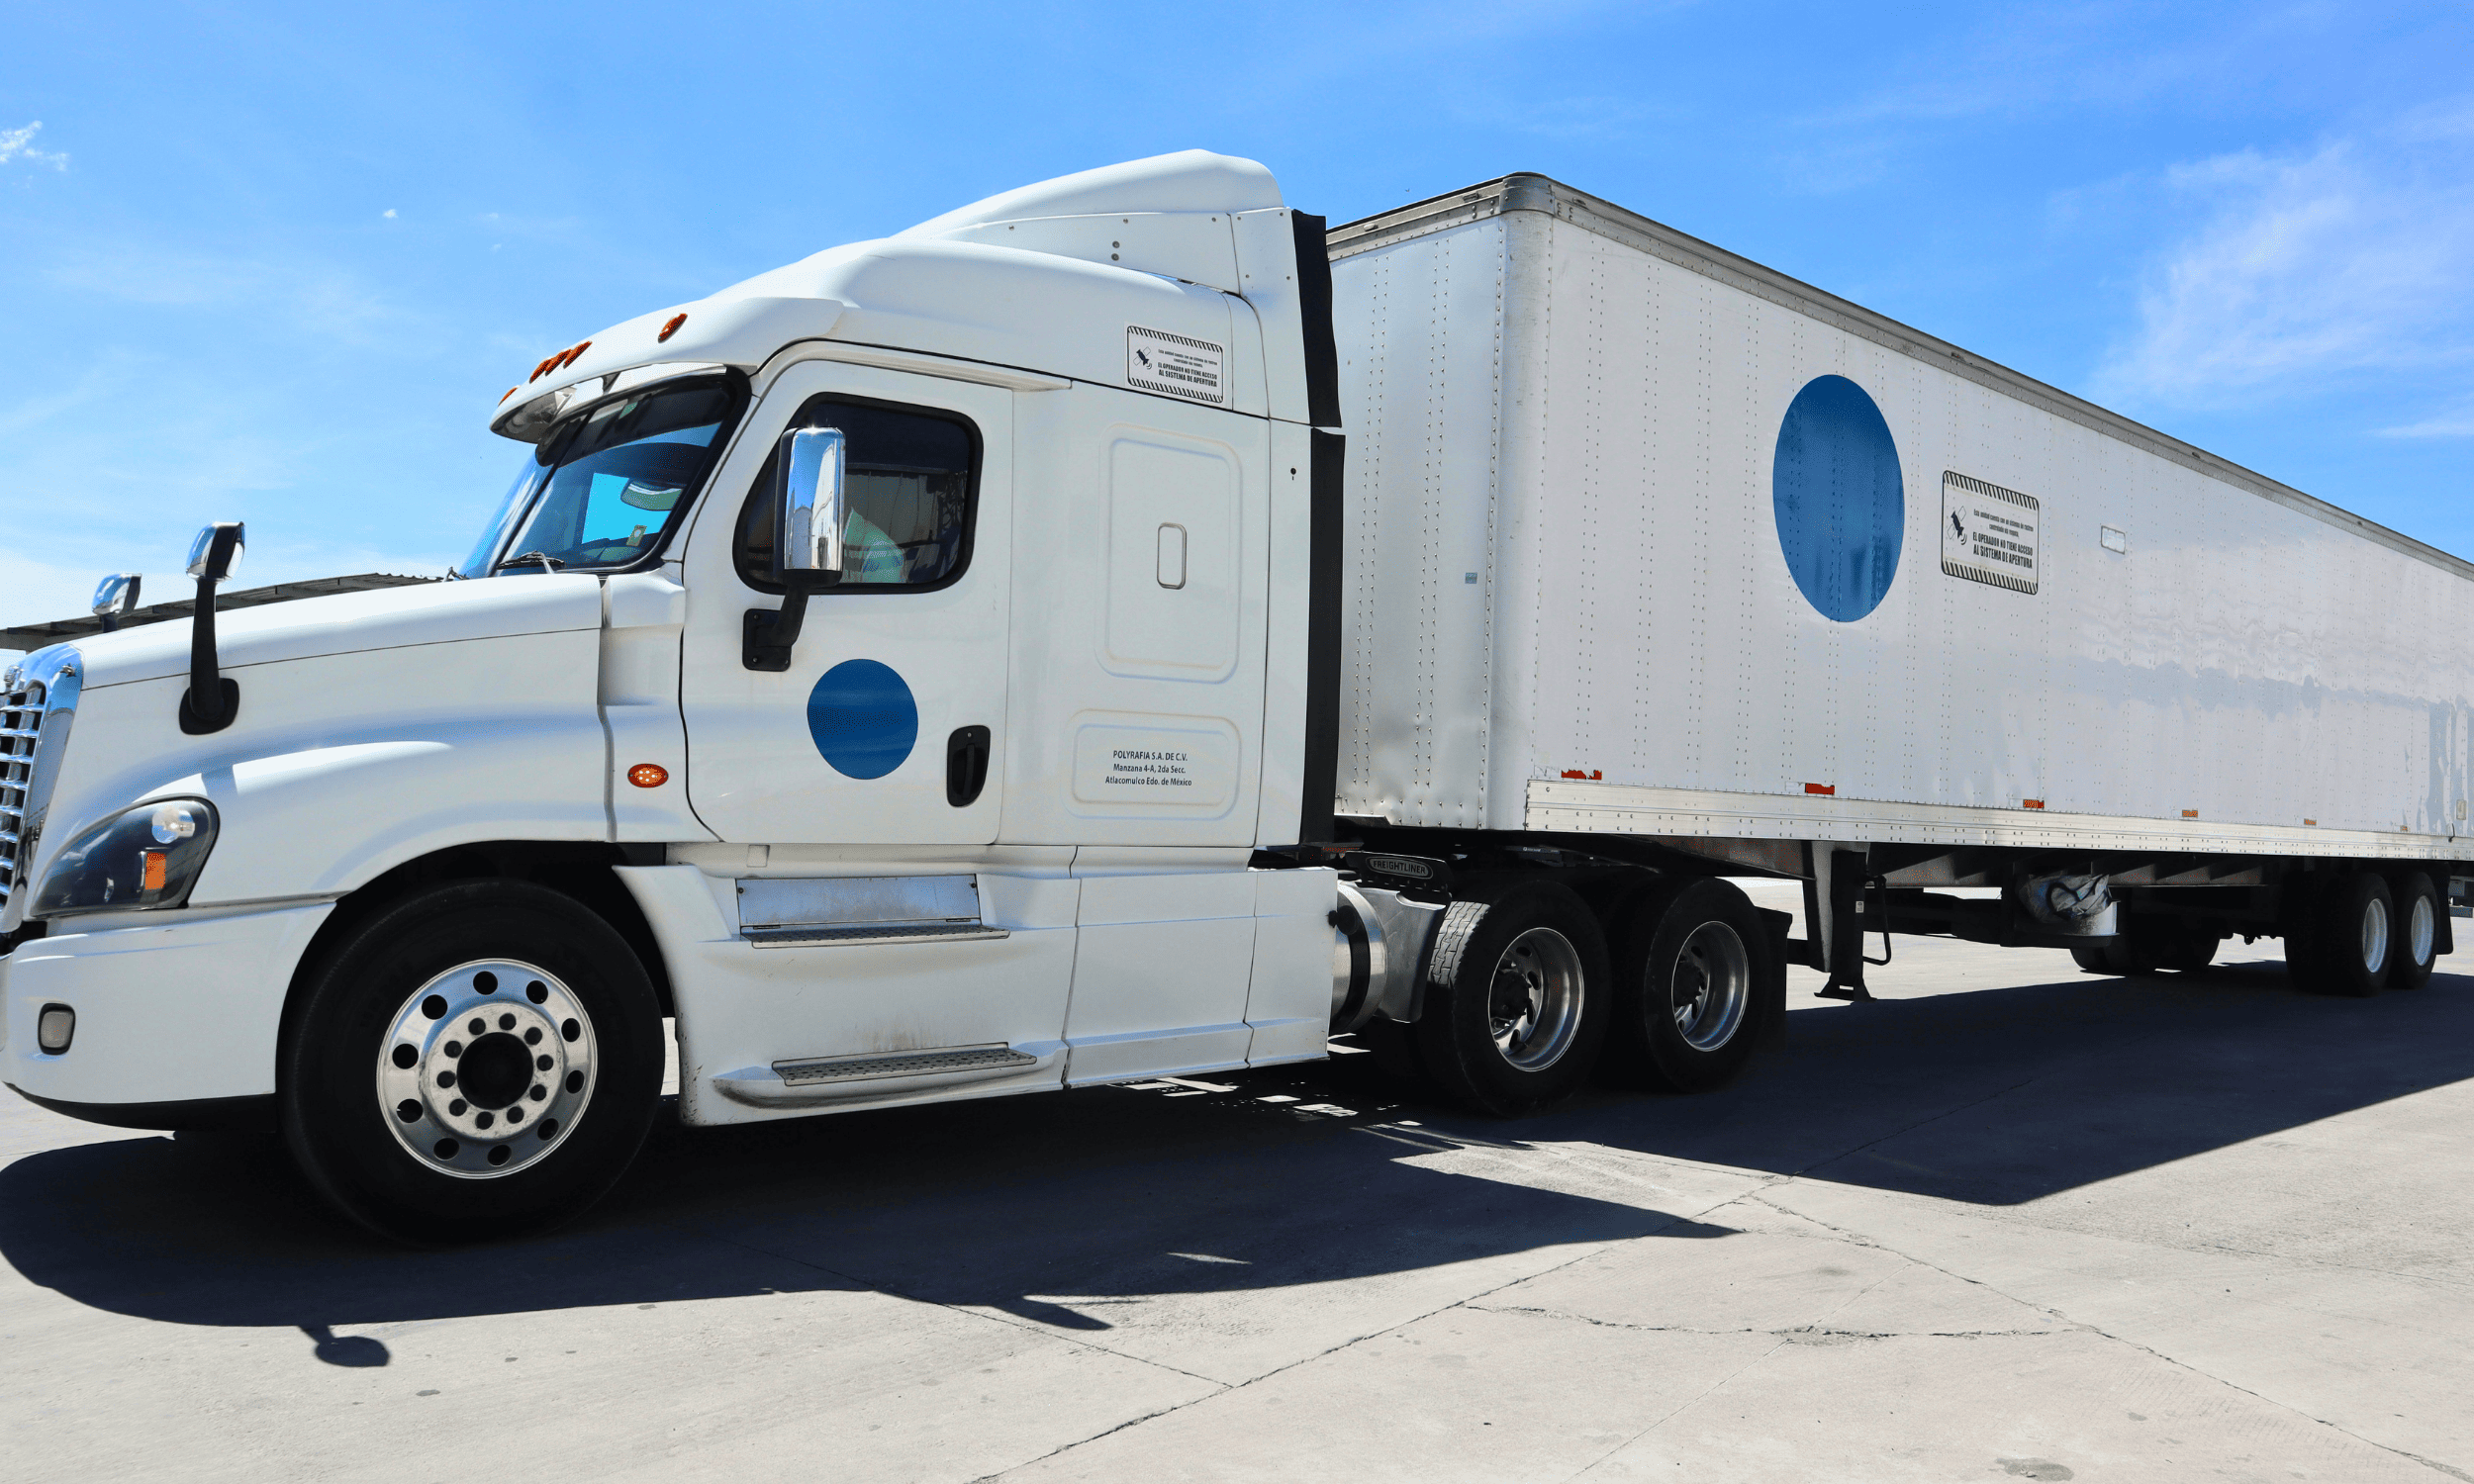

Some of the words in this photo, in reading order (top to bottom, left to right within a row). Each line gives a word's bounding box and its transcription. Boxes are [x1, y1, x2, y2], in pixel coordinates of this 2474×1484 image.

[1163, 363, 1184, 372] OPERADOR
[1202, 371, 1217, 380] ACCESO
[1166, 371, 1186, 381] SISTEMA
[1193, 377, 1217, 387] APERTURA
[1973, 532, 1977, 541] EL
[1978, 533, 1999, 547] OPERADOR
[2000, 539, 2005, 548] NO
[2007, 541, 2017, 552] TIENE
[2018, 544, 2033, 556] ACCESO
[1973, 544, 1979, 555] AL
[1980, 545, 2001, 560] SISTEMA
[2002, 551, 2008, 562] DE
[2009, 553, 2033, 569] APERTURA
[1113, 750, 1150, 760] POLYRAFIA
[1105, 776, 1145, 785] Atlacomulco
[1374, 861, 1425, 874] FREIGHTLINER
